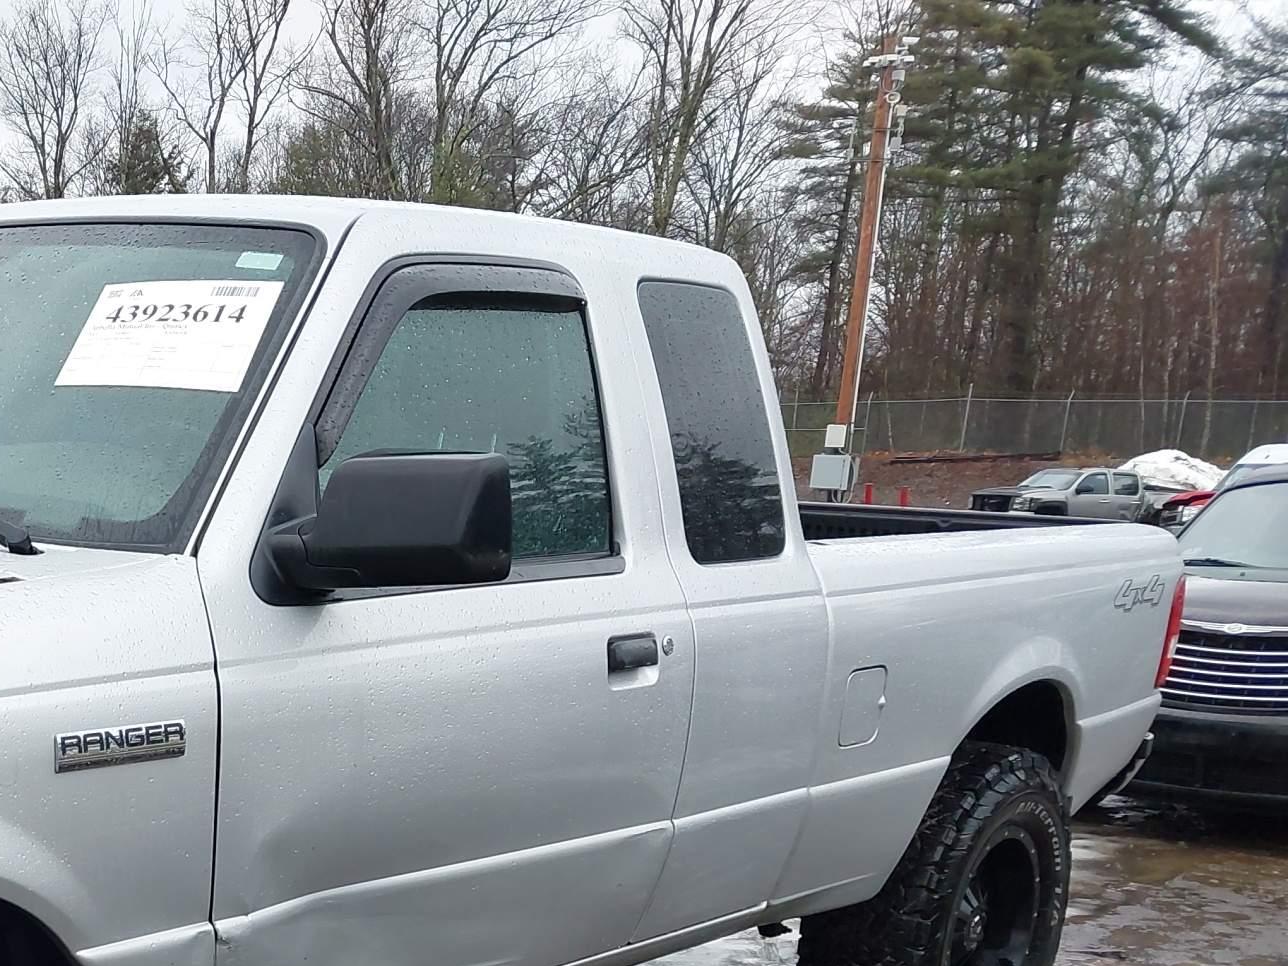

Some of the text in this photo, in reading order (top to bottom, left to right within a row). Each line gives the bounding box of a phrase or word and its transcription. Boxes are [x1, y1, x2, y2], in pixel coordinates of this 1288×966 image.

[106, 303, 248, 324] 43923614
[1114, 574, 1165, 611] 4x4
[60, 722, 186, 757] RANGER
